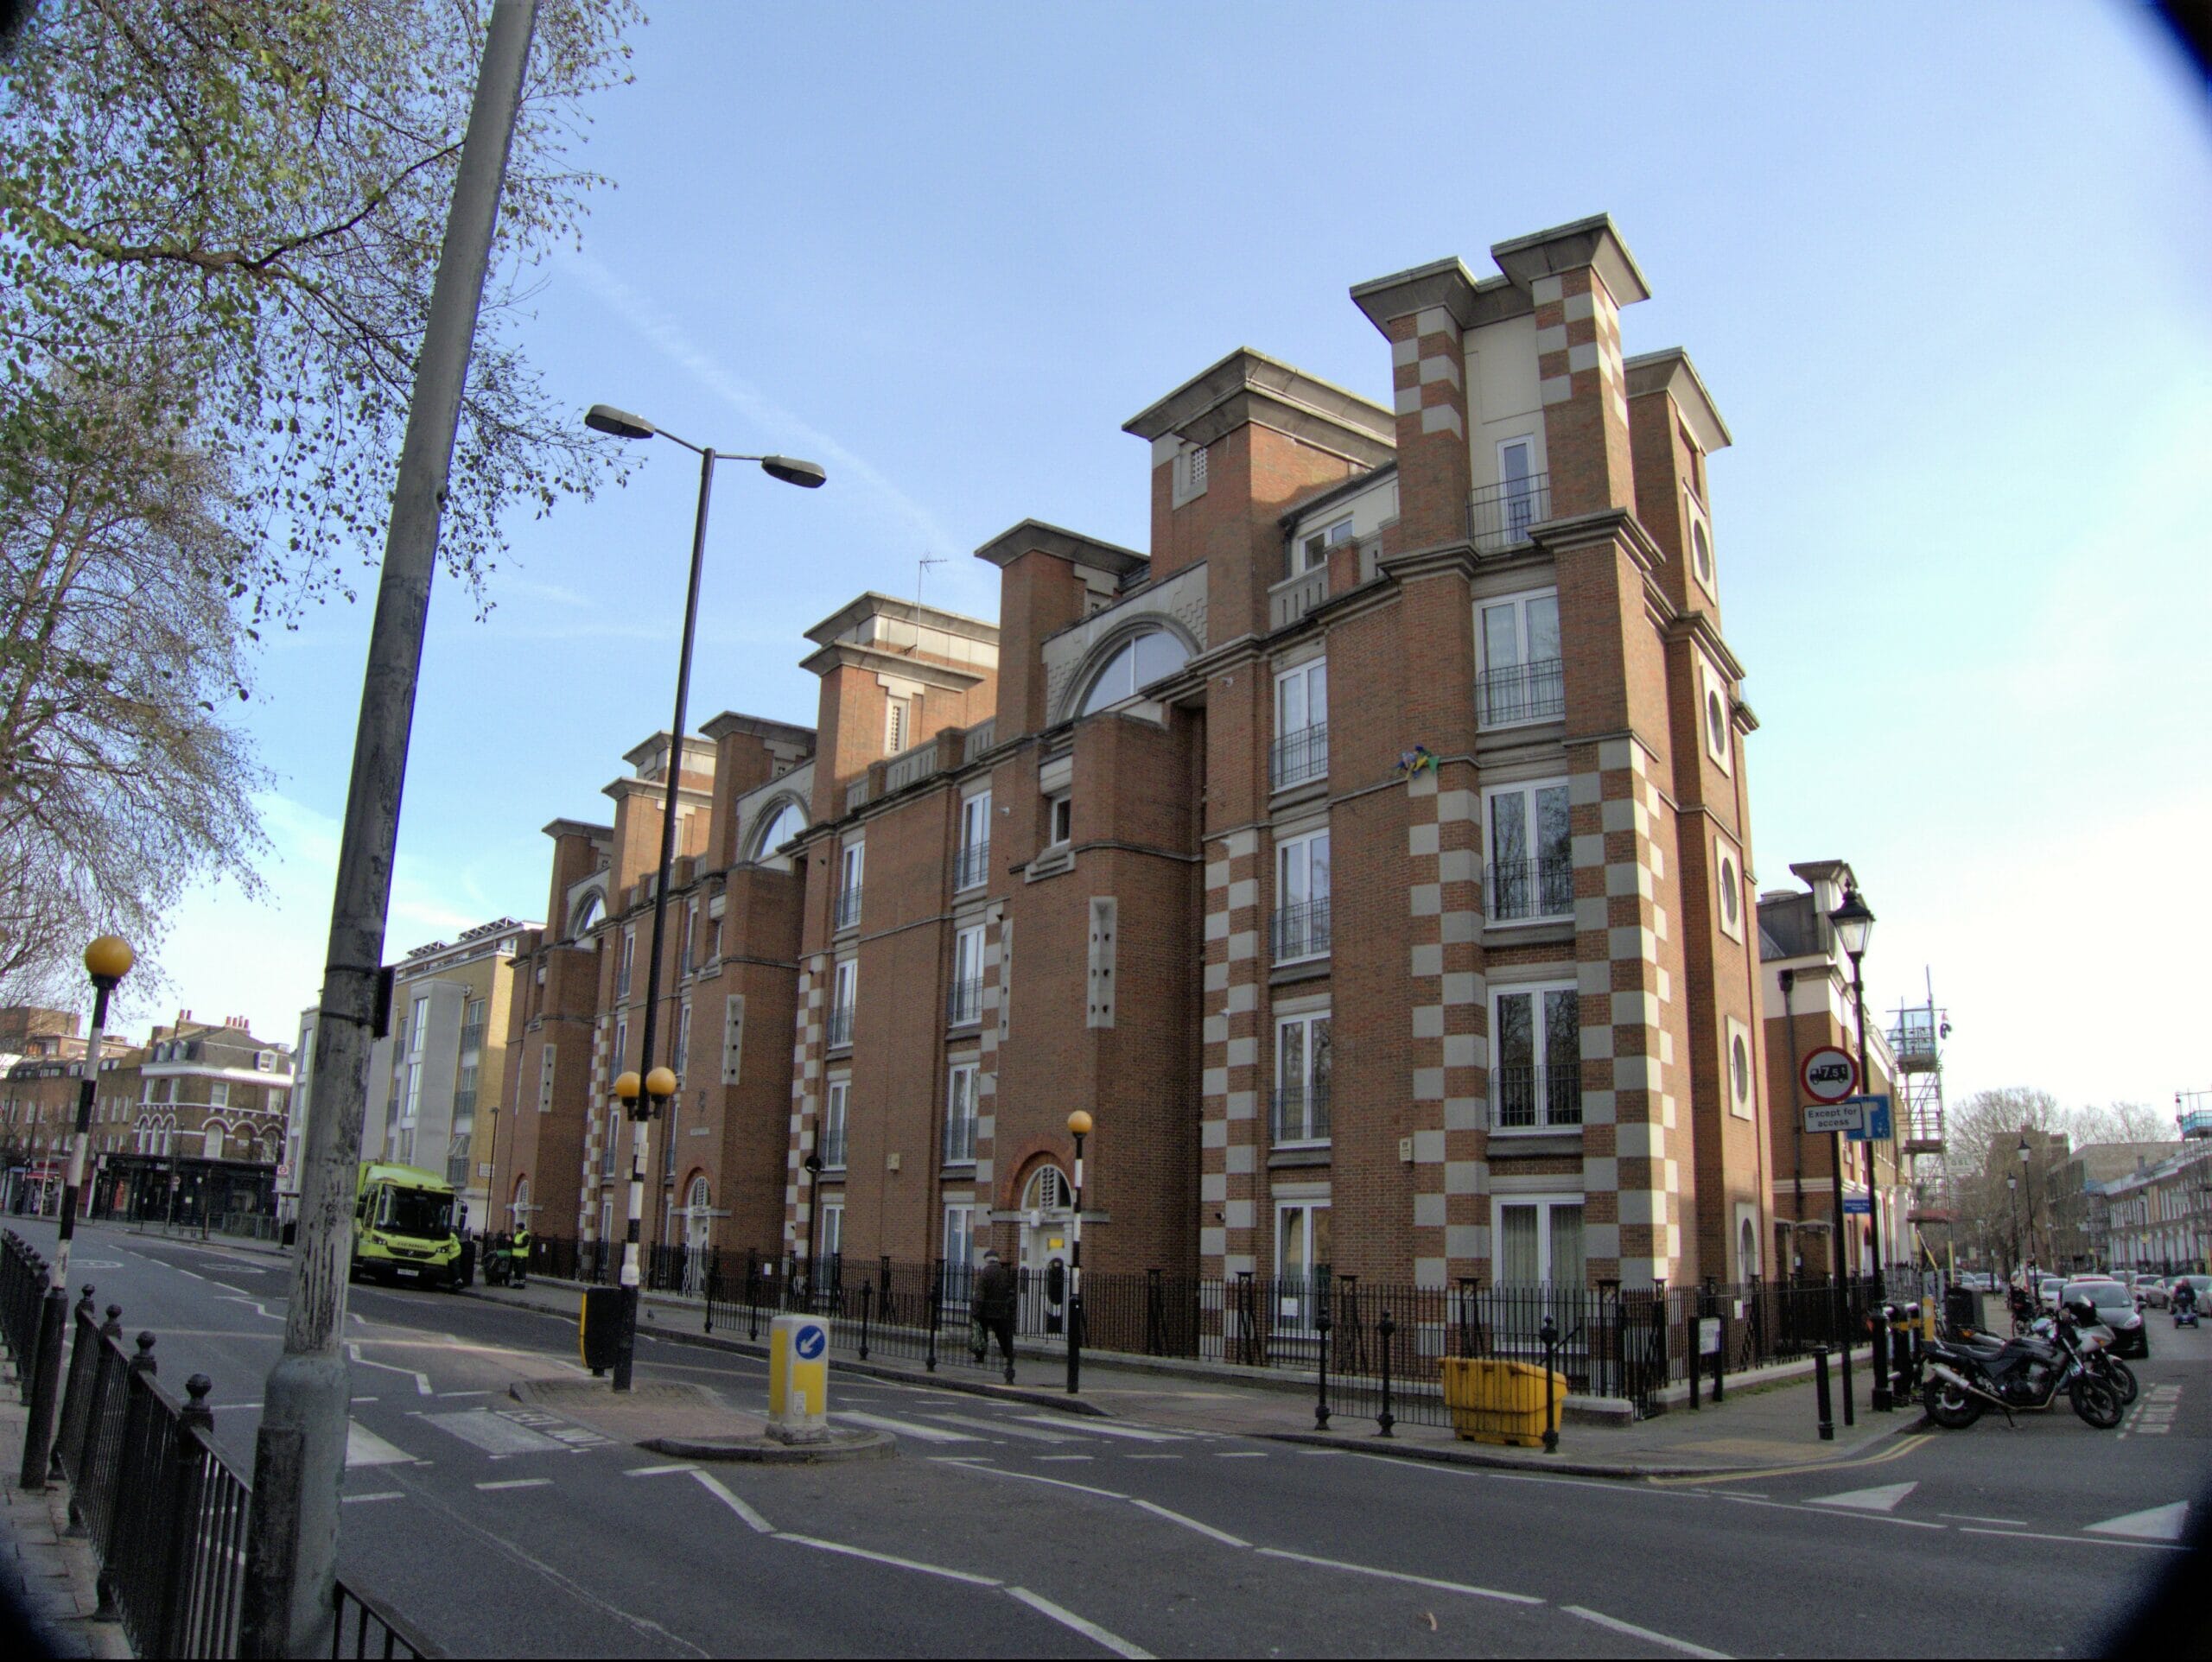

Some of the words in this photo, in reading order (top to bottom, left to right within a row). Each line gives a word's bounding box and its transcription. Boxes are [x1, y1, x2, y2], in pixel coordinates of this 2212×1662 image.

[1821, 1066, 1839, 1078] 7.5
[1808, 1109, 1840, 1119] Except
[1817, 1119, 1849, 1127] access
